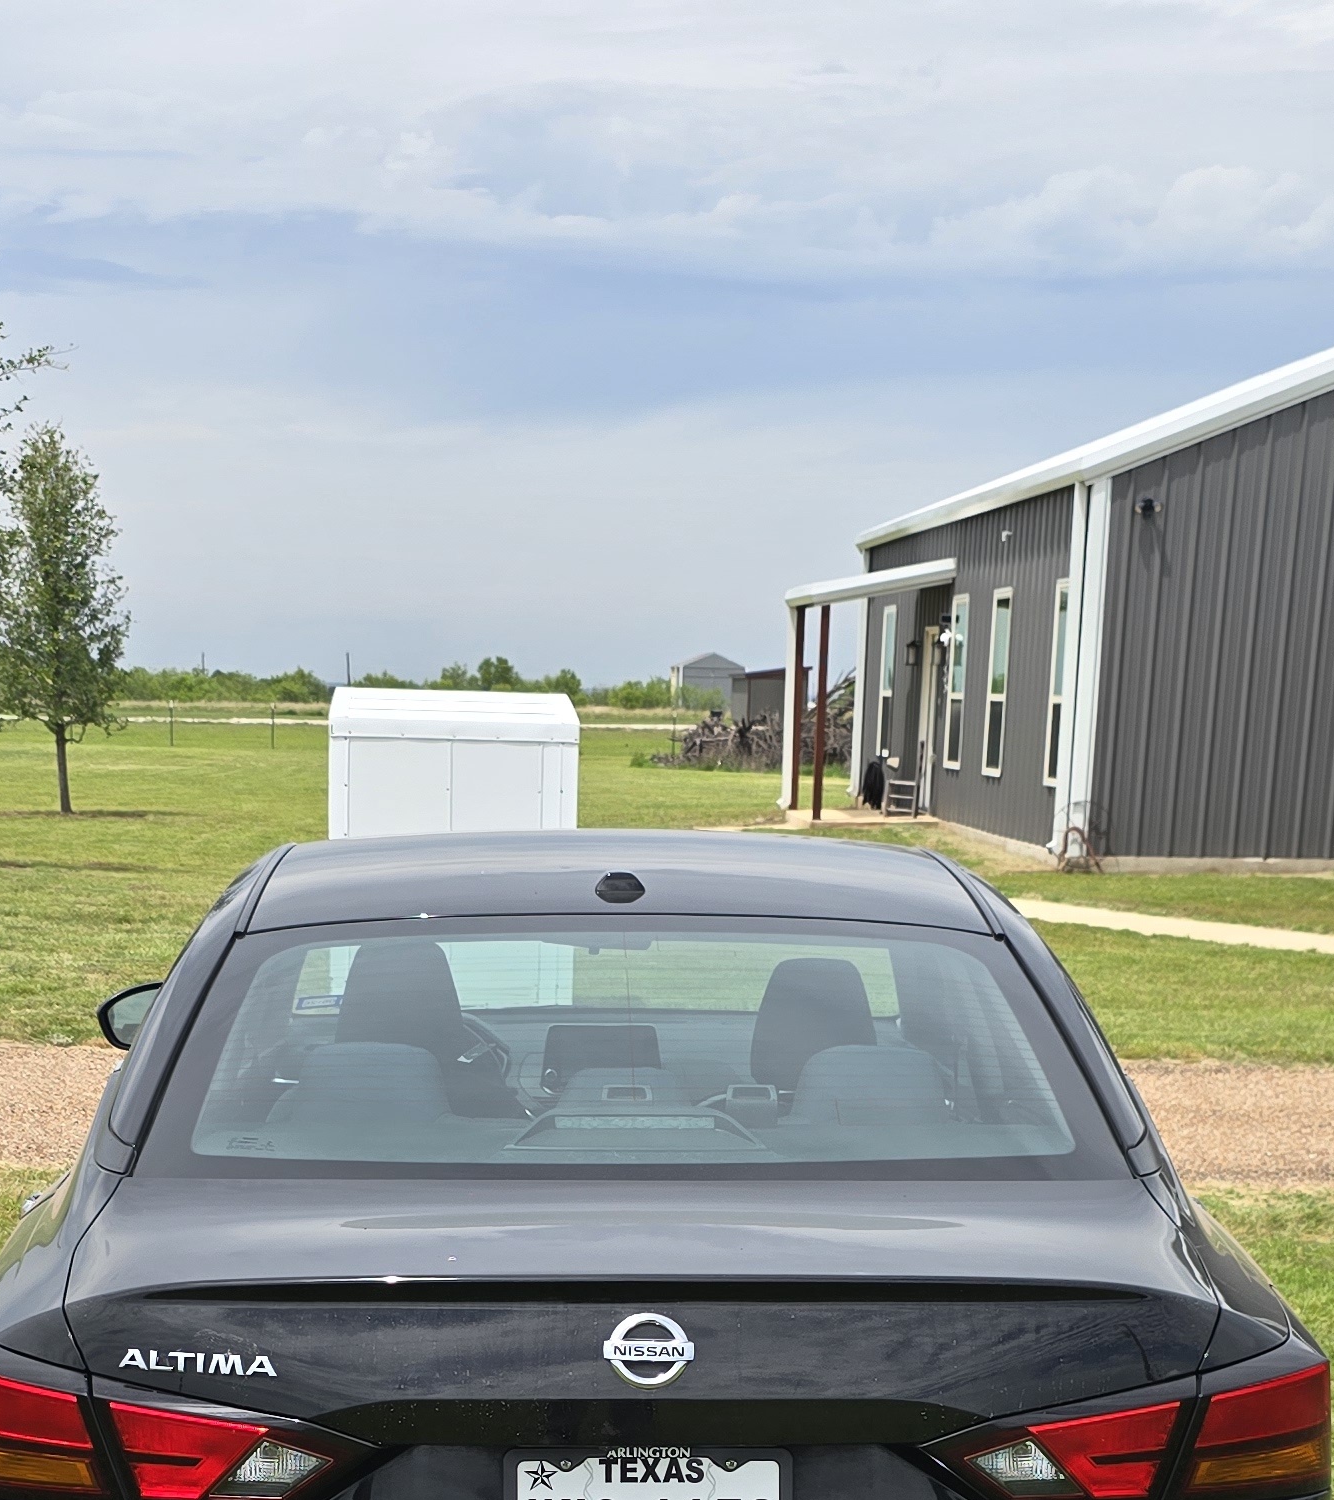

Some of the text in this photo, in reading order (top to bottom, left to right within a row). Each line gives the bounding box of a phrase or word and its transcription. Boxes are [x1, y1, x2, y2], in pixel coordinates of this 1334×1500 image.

[613, 1345, 685, 1358] NISSAN
[118, 1348, 278, 1377] ALTIMA
[607, 1446, 691, 1458] ARLINGTON
[598, 1458, 705, 1484] TEXAS
